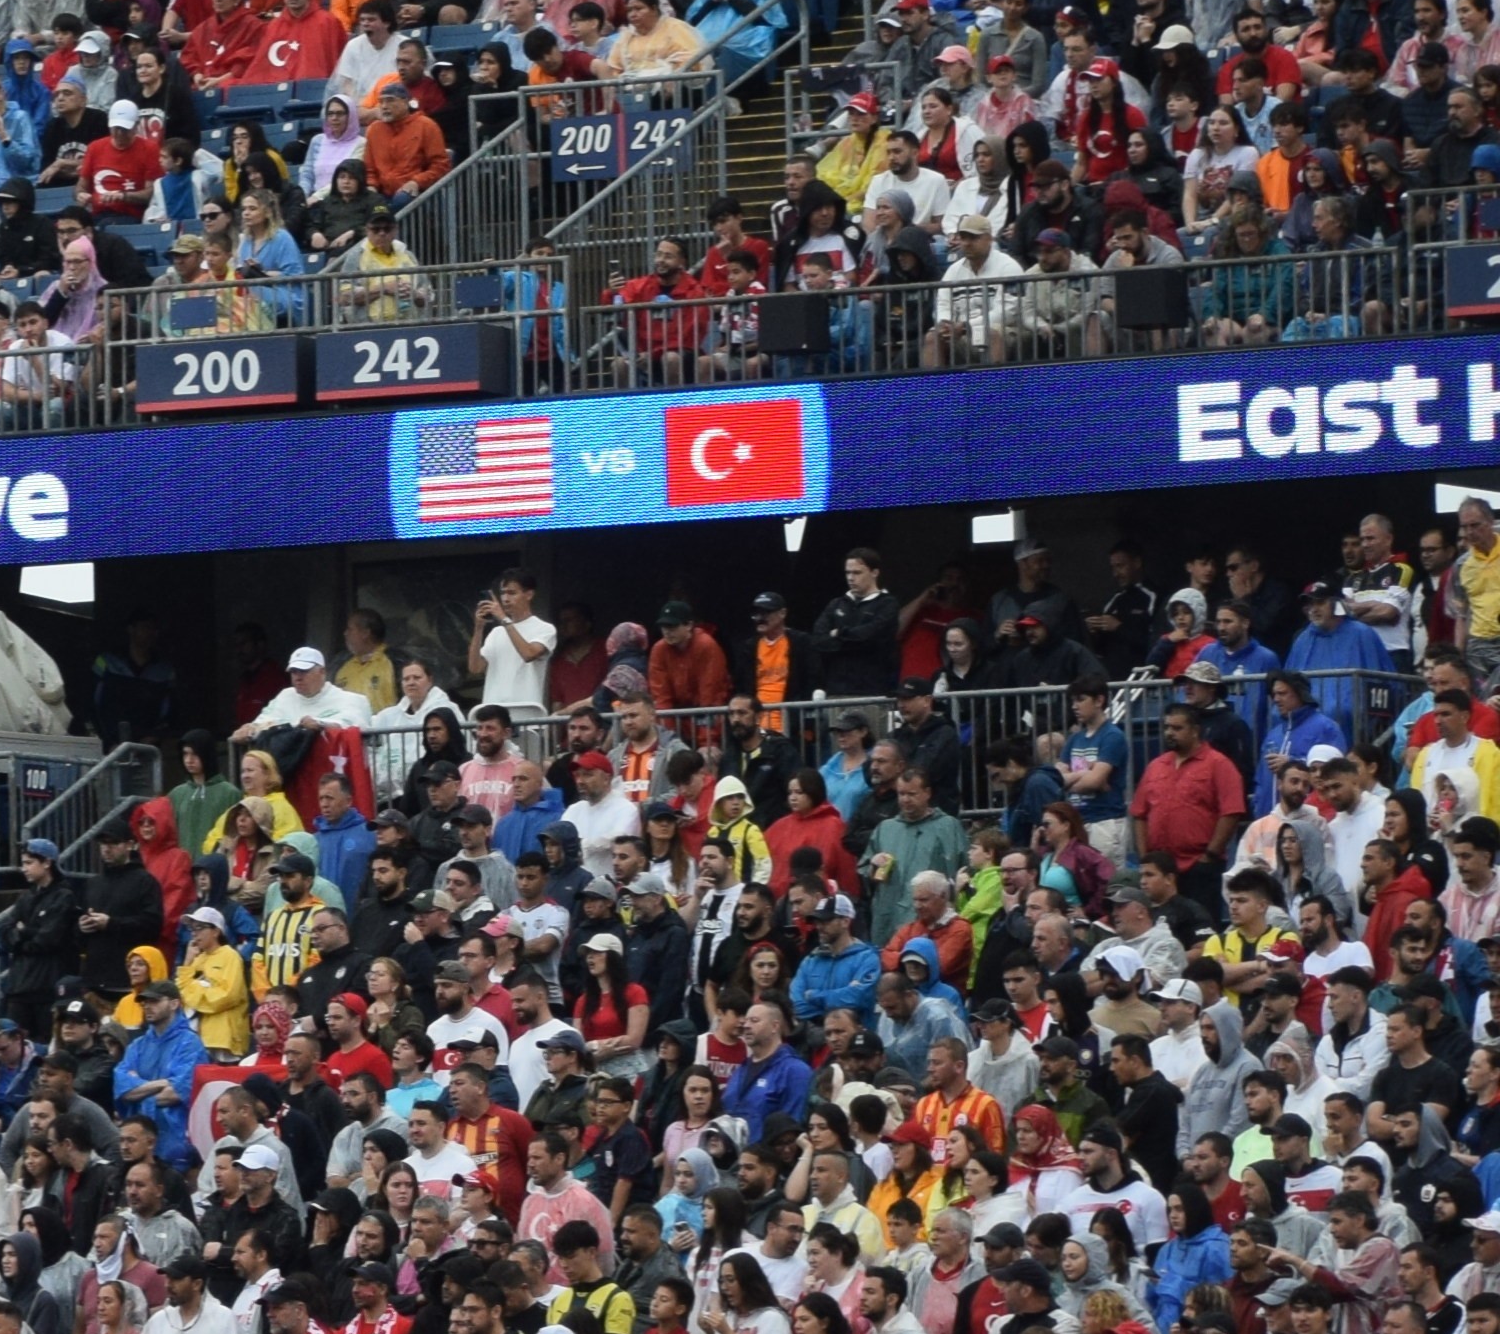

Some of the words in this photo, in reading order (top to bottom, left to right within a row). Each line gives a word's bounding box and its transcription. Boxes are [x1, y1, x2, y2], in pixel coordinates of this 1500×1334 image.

[558, 123, 611, 157] 200
[172, 348, 260, 395] 200
[353, 337, 441, 383] 242
[1178, 366, 1441, 462] East
[580, 449, 636, 475] vs
[1370, 689, 1388, 708] 141
[26, 769, 48, 789] 100
[267, 942, 301, 958] AVIS
